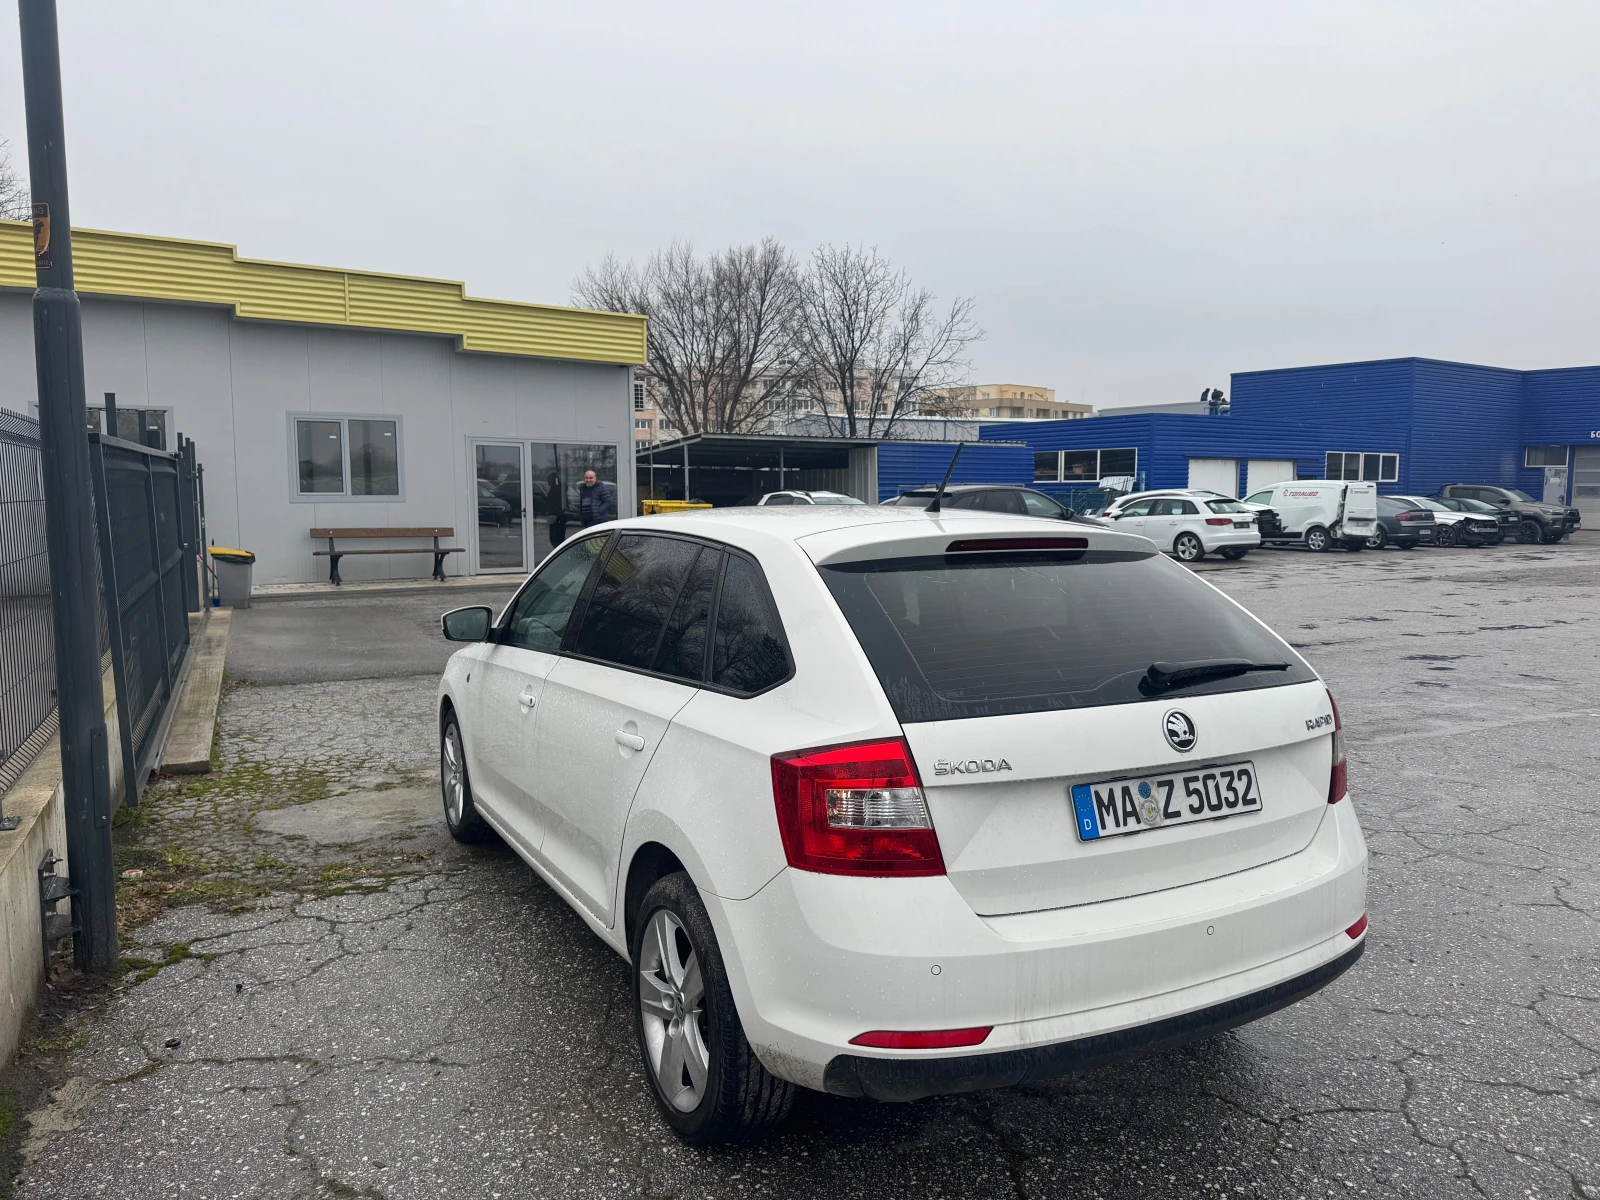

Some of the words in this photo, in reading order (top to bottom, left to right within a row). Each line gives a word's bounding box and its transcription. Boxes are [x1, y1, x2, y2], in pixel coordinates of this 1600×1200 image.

[934, 758, 1013, 776] ŠKODA
[1094, 785, 1141, 830] MA
[1156, 779, 1182, 820] Z
[1183, 768, 1257, 815] 5032
[1084, 818, 1092, 831] D
